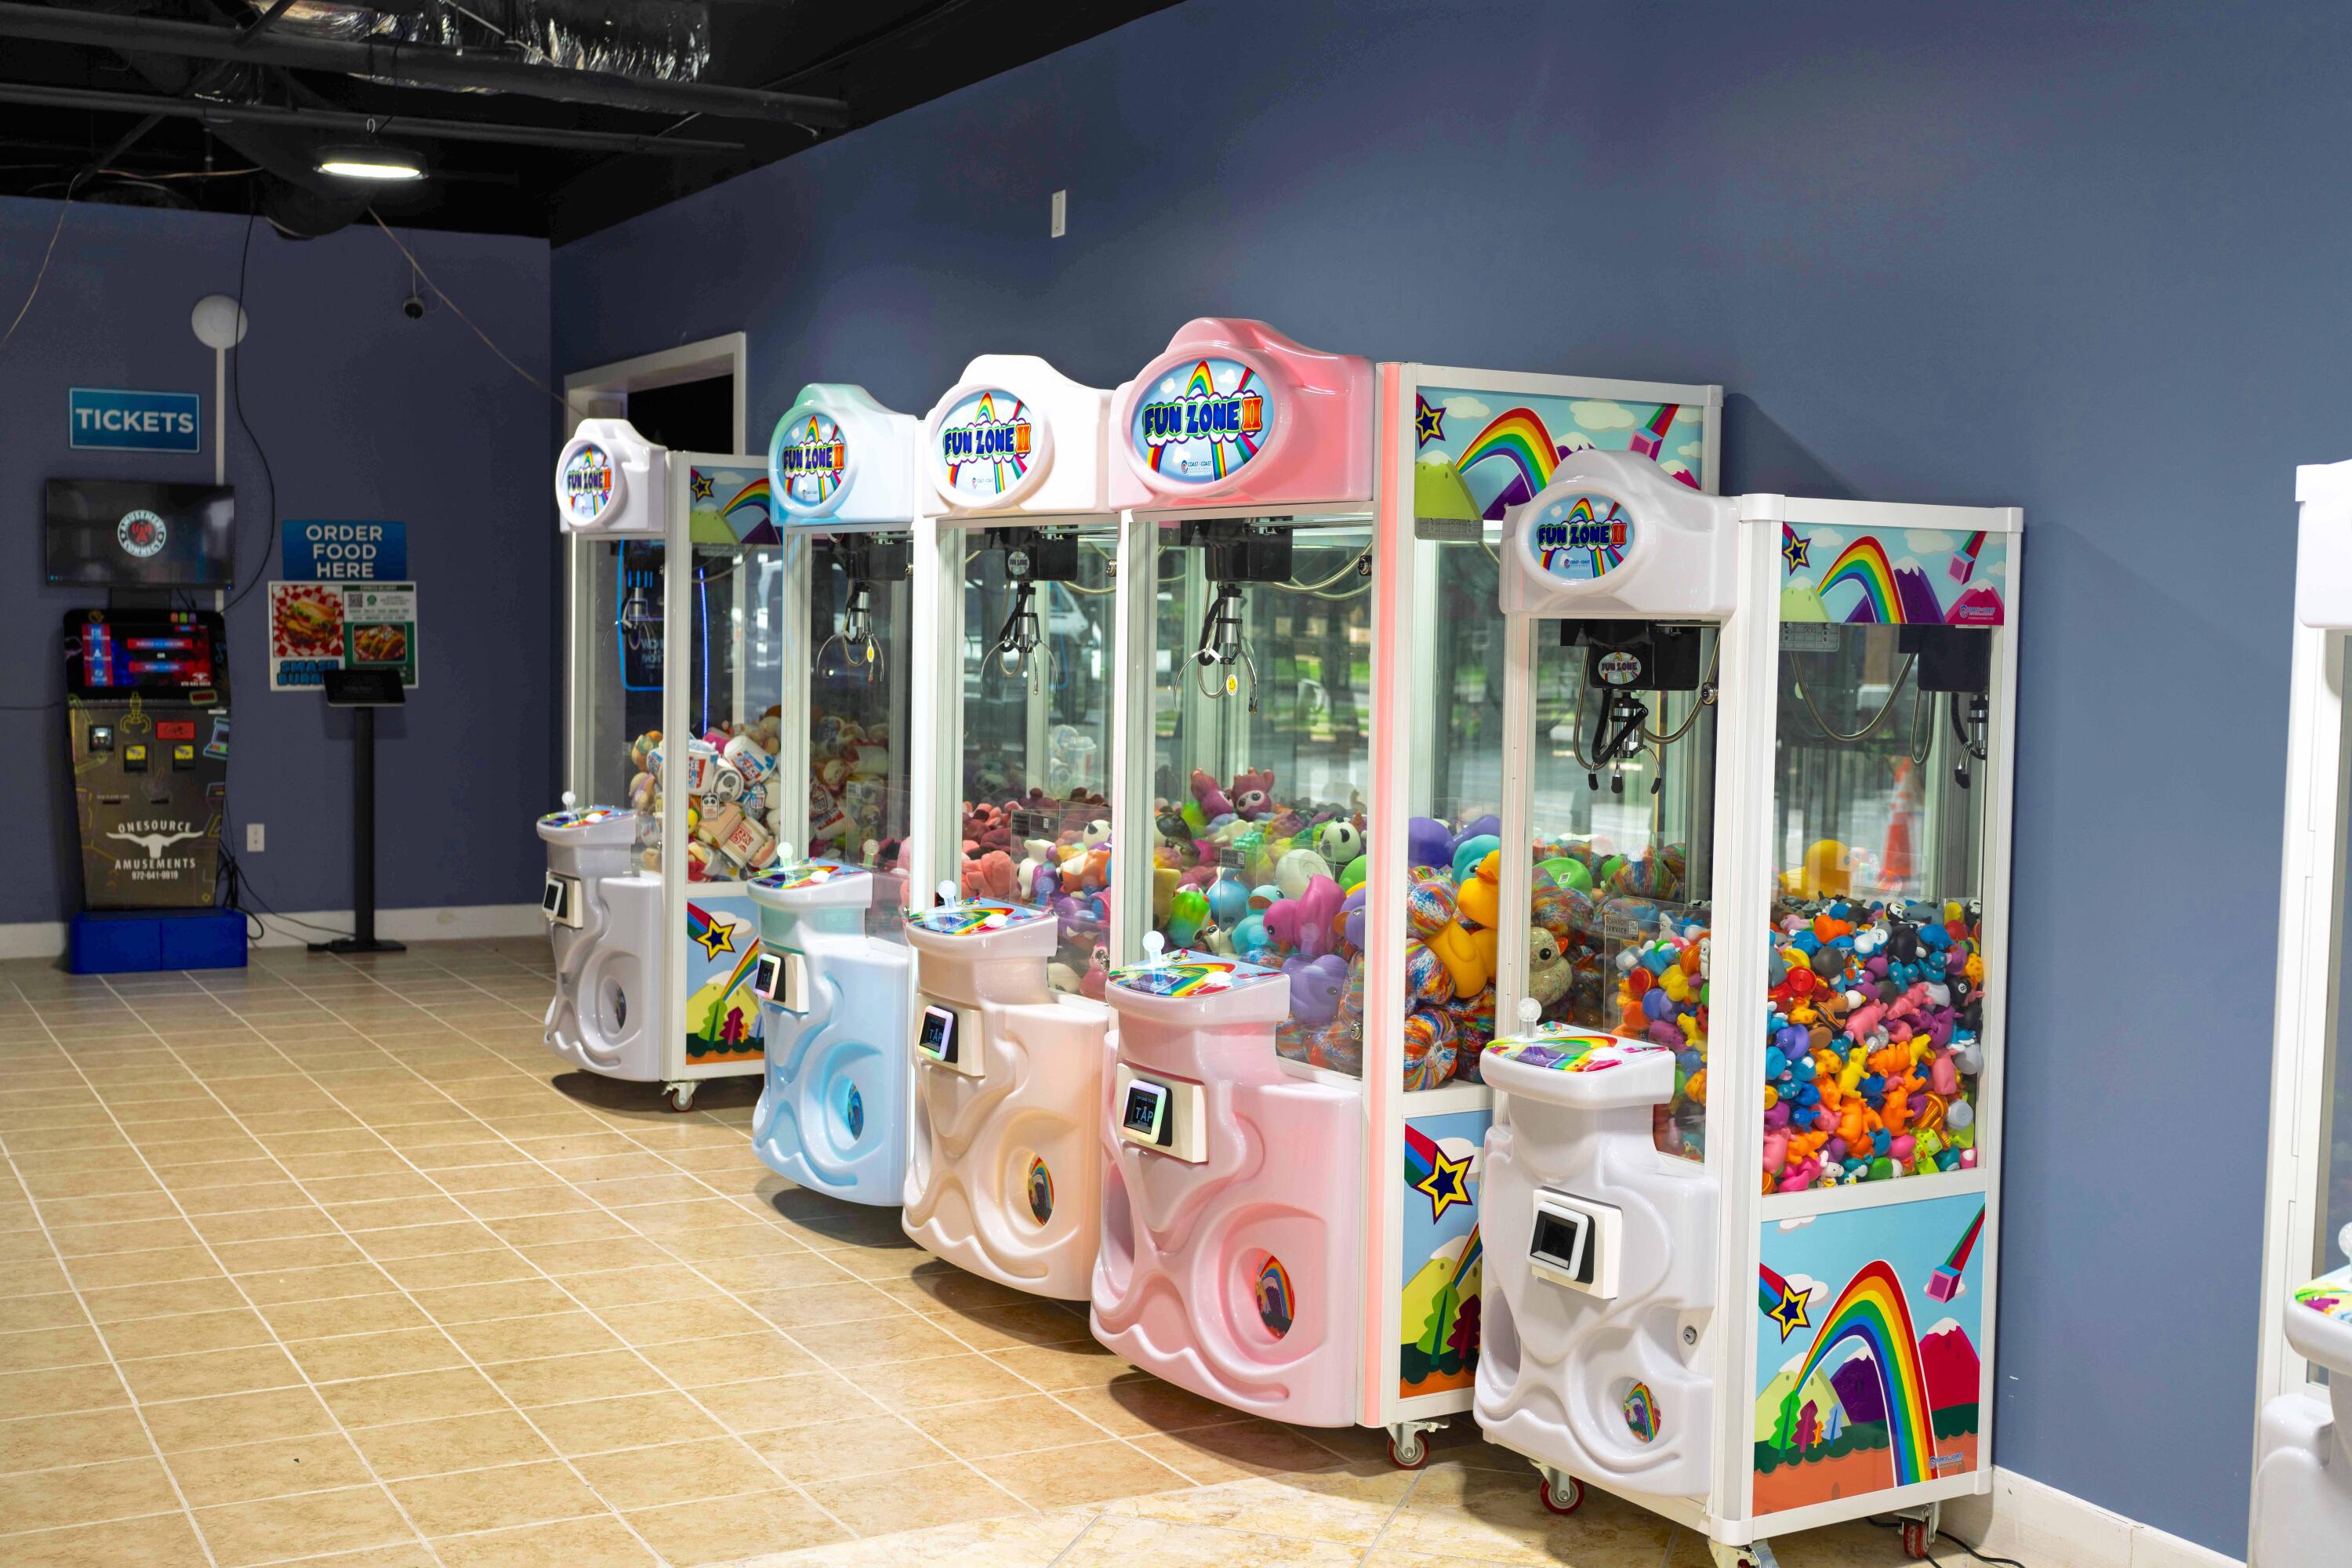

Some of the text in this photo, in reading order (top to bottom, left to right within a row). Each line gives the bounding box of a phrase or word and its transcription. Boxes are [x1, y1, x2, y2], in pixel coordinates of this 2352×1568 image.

[75, 408, 194, 434] TICKETS
[1144, 396, 1263, 437] FUN ZONE II
[944, 423, 1031, 458] FUN ZONE II
[783, 447, 804, 471] FUN
[804, 445, 833, 471] ZONE
[568, 471, 583, 491] FUN
[583, 470, 603, 491] ZONE
[306, 524, 383, 541] ORDER
[1537, 523, 1627, 546] FUN ZONE II
[313, 543, 377, 560] FOOD
[317, 562, 374, 578] HERE
[1617, 662, 1638, 671] ZONE
[278, 672, 324, 686] BURG
[118, 820, 191, 833] ONESOURCE
[115, 858, 195, 869] AMUSEMENTS
[1605, 925, 1628, 934] SERVICE
[1136, 1105, 1153, 1122] TAP
